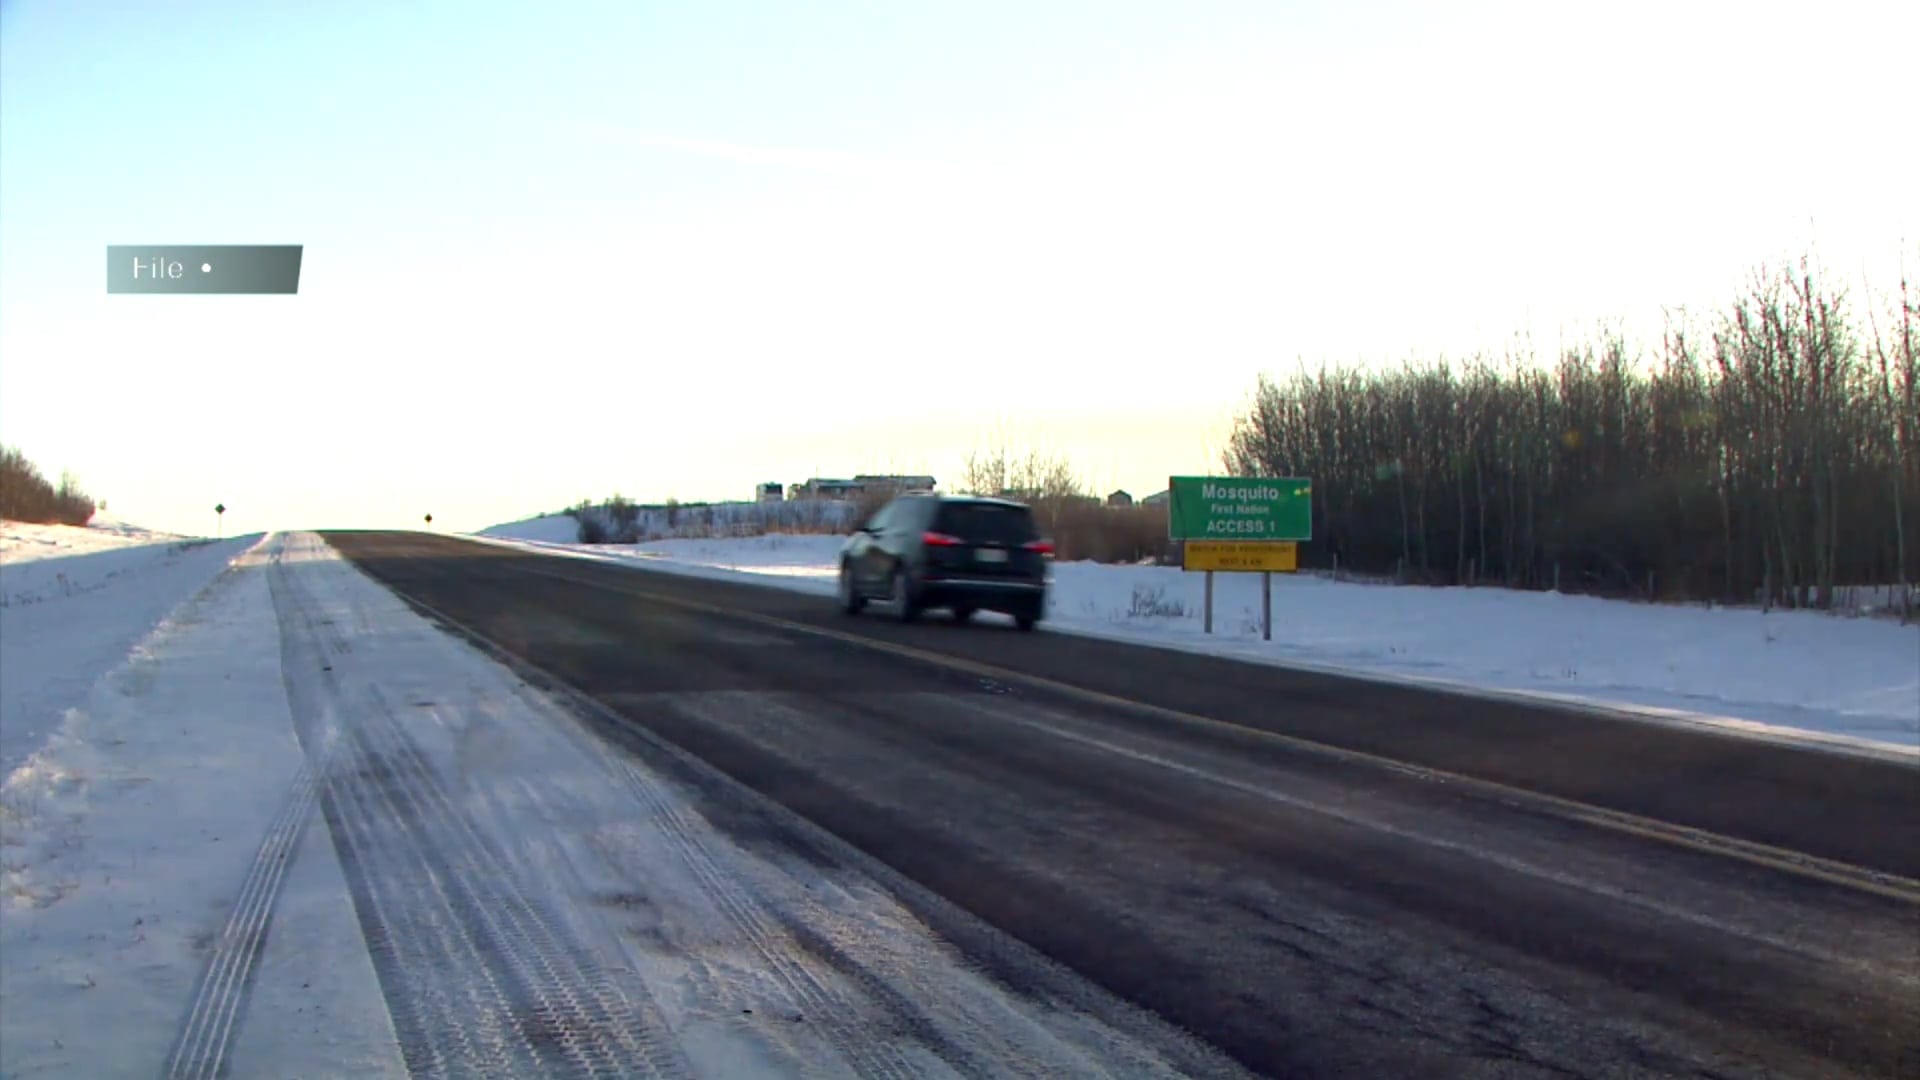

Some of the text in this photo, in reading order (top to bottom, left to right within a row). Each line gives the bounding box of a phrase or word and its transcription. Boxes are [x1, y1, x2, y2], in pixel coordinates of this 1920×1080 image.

[1202, 483, 1279, 502] Mosquito
[1211, 503, 1270, 515] First Nation
[1206, 519, 1275, 533] ACCESS 1
